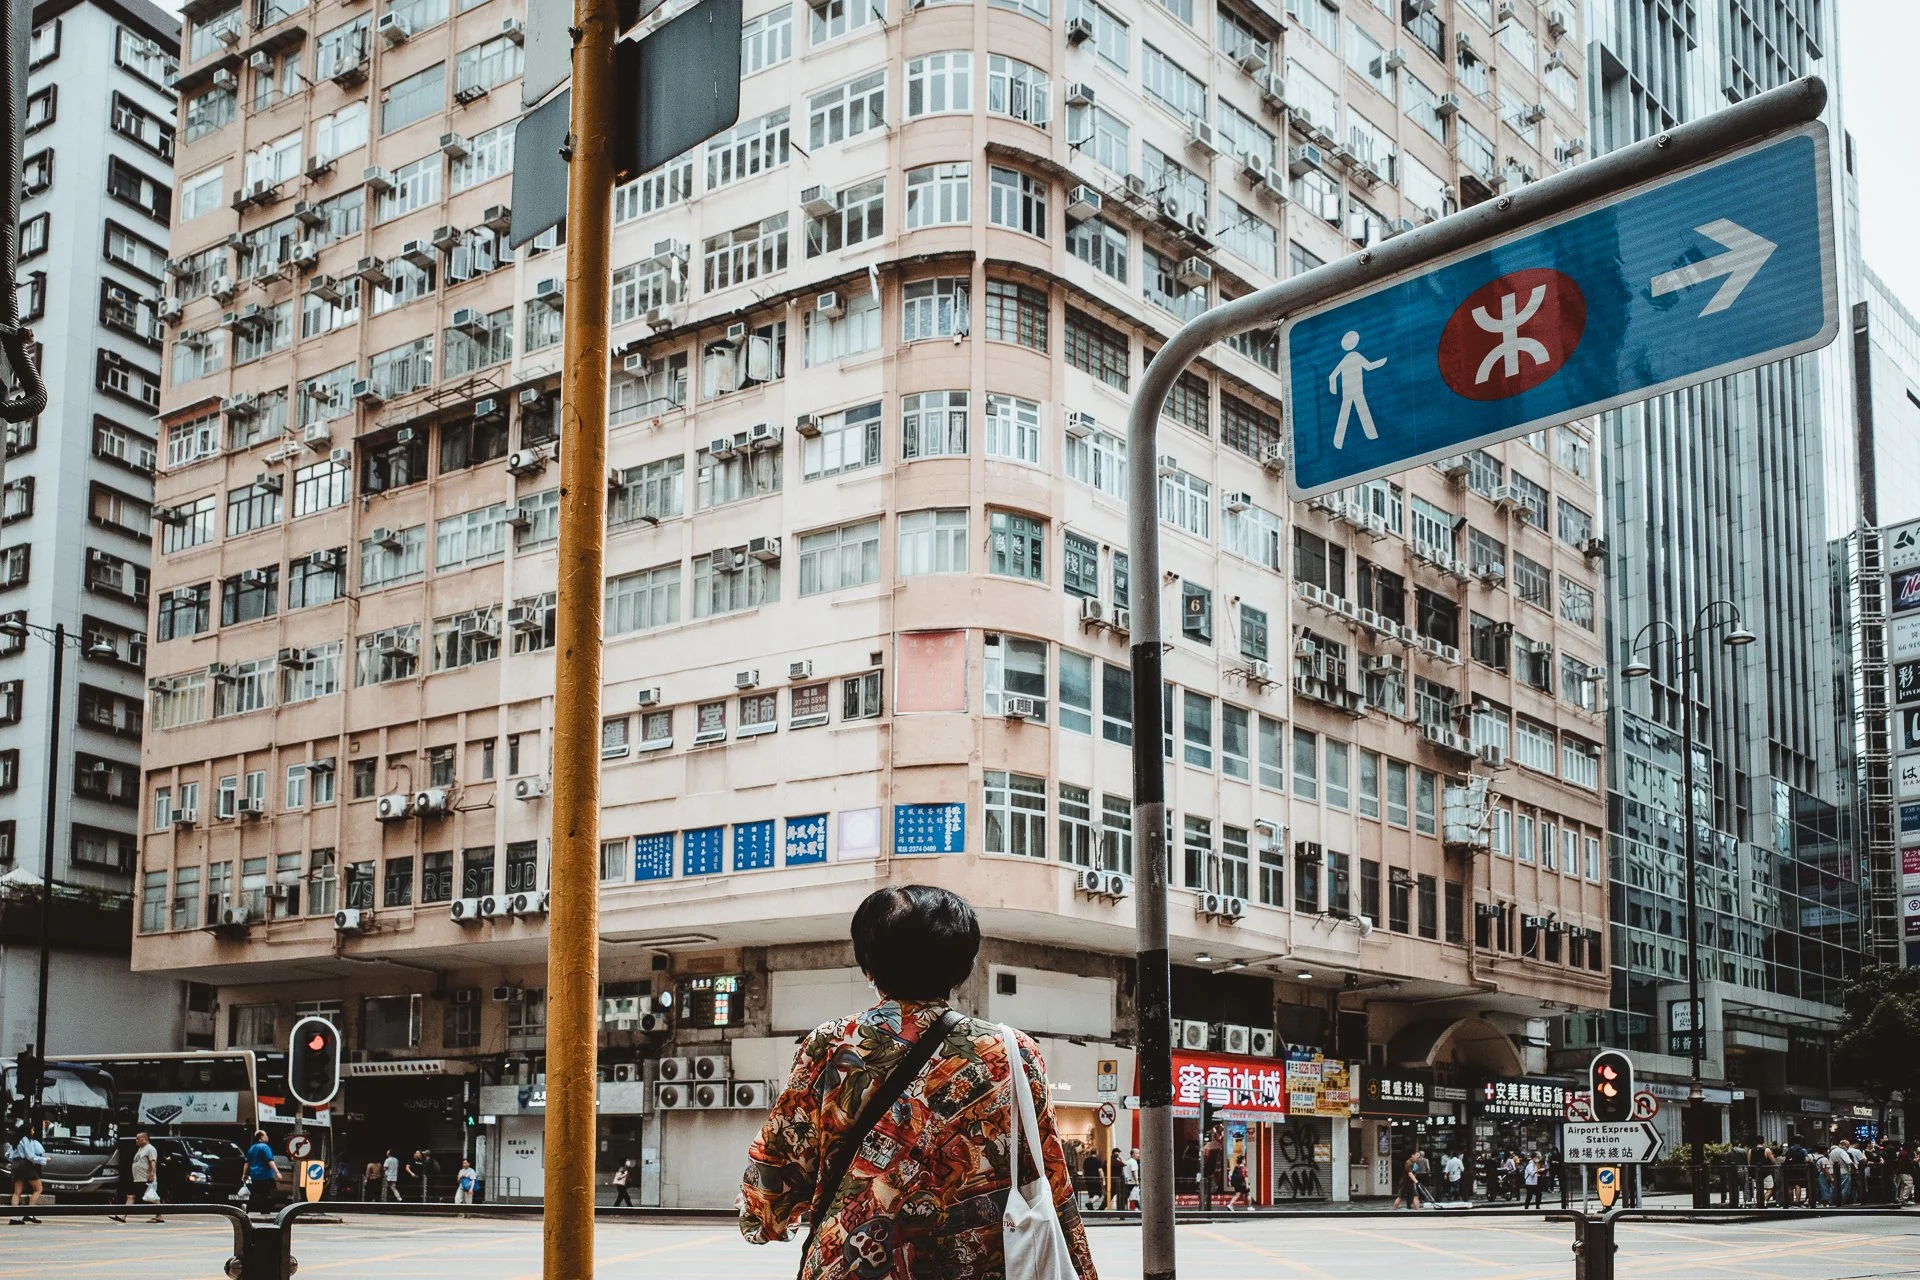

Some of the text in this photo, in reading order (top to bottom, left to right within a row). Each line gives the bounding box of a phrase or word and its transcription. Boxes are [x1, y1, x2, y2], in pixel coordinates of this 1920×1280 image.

[1190, 599, 1200, 612] 6
[1178, 1064, 1281, 1108] 蜜雪冰城
[1495, 1082, 1564, 1104] 安美藥粧百貨
[1568, 1125, 1639, 1135] Airport Express
[1586, 1136, 1620, 1144] Station
[1568, 1147, 1633, 1159] 機場快綫站
